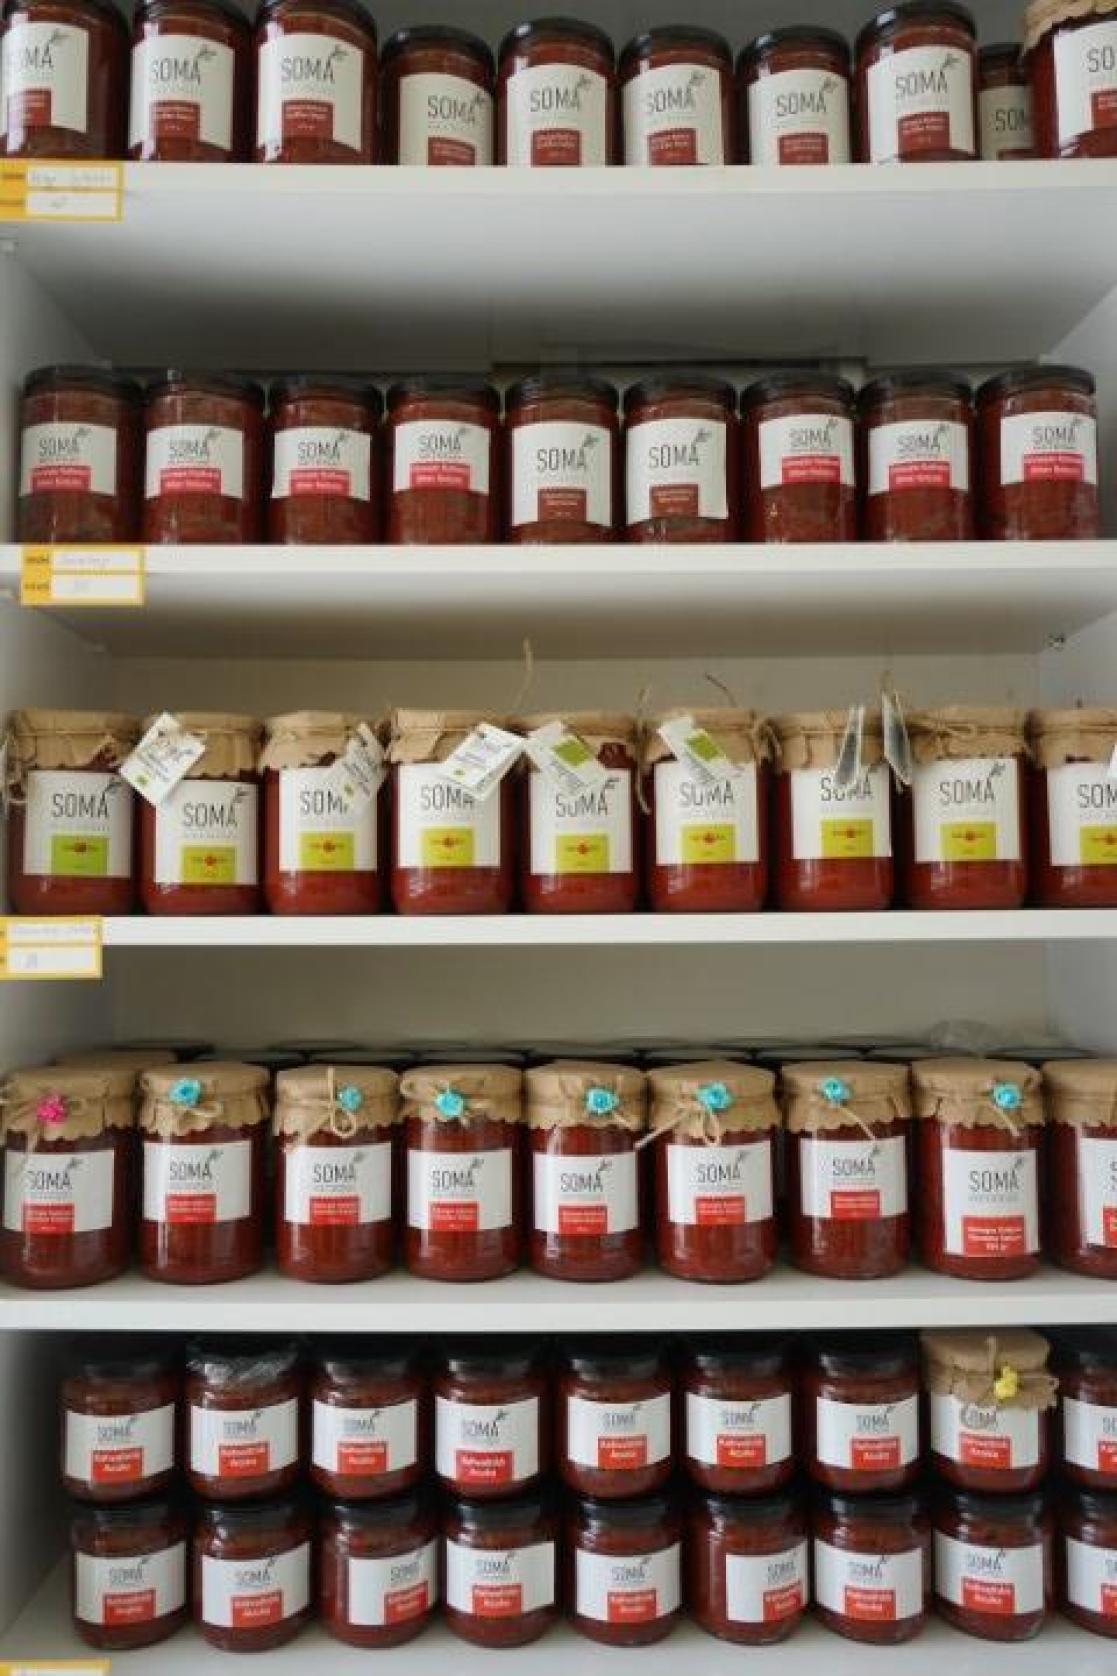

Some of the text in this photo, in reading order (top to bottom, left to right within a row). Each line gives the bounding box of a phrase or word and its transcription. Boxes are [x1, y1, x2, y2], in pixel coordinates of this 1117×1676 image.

[149, 59, 202, 85] SOMA
[281, 58, 335, 84] SOMA
[896, 71, 948, 98] SOMA
[427, 95, 476, 125] SOMA
[530, 88, 581, 113] SOMA
[646, 88, 697, 114] SOMA
[776, 91, 827, 118] SOMA
[419, 434, 462, 451] SOMA
[1032, 425, 1077, 444] SOMA
[38, 437, 80, 458] SOMA
[297, 441, 341, 461] SOMA
[648, 444, 700, 469] SOMA
[537, 448, 587, 472] SOMA
[300, 790, 348, 816] SOM
[939, 779, 996, 805] SOMA
[52, 793, 109, 819] SOMA
[183, 803, 238, 828] SOMA
[169, 1161, 213, 1180] SOMA
[313, 1164, 357, 1183] SOMA
[432, 1169, 475, 1189] SOMA
[697, 1163, 742, 1183] SOMA
[832, 1158, 877, 1177] SOMA
[560, 1173, 604, 1193] SOMA
[969, 1170, 1021, 1193] SOMA
